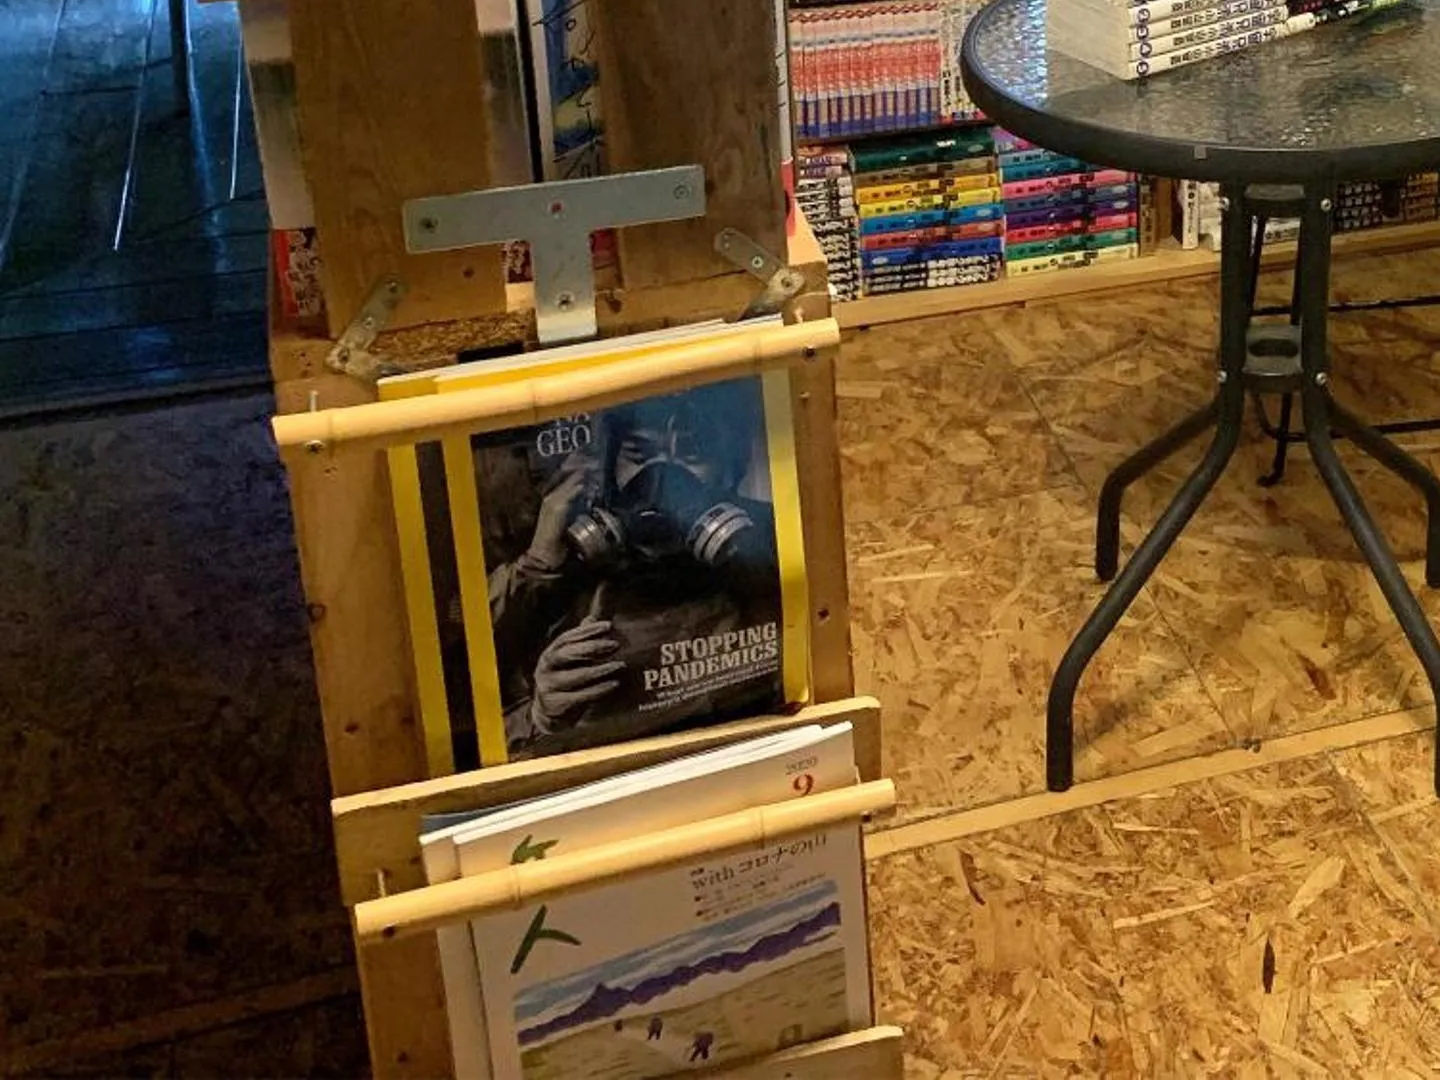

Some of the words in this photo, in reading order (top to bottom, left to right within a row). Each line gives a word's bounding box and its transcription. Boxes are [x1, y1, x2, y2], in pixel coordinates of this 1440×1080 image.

[537, 425, 591, 457] GEO
[660, 622, 778, 666] STOPPING
[643, 640, 779, 691] PANDEMICS
[792, 774, 814, 796] 9
